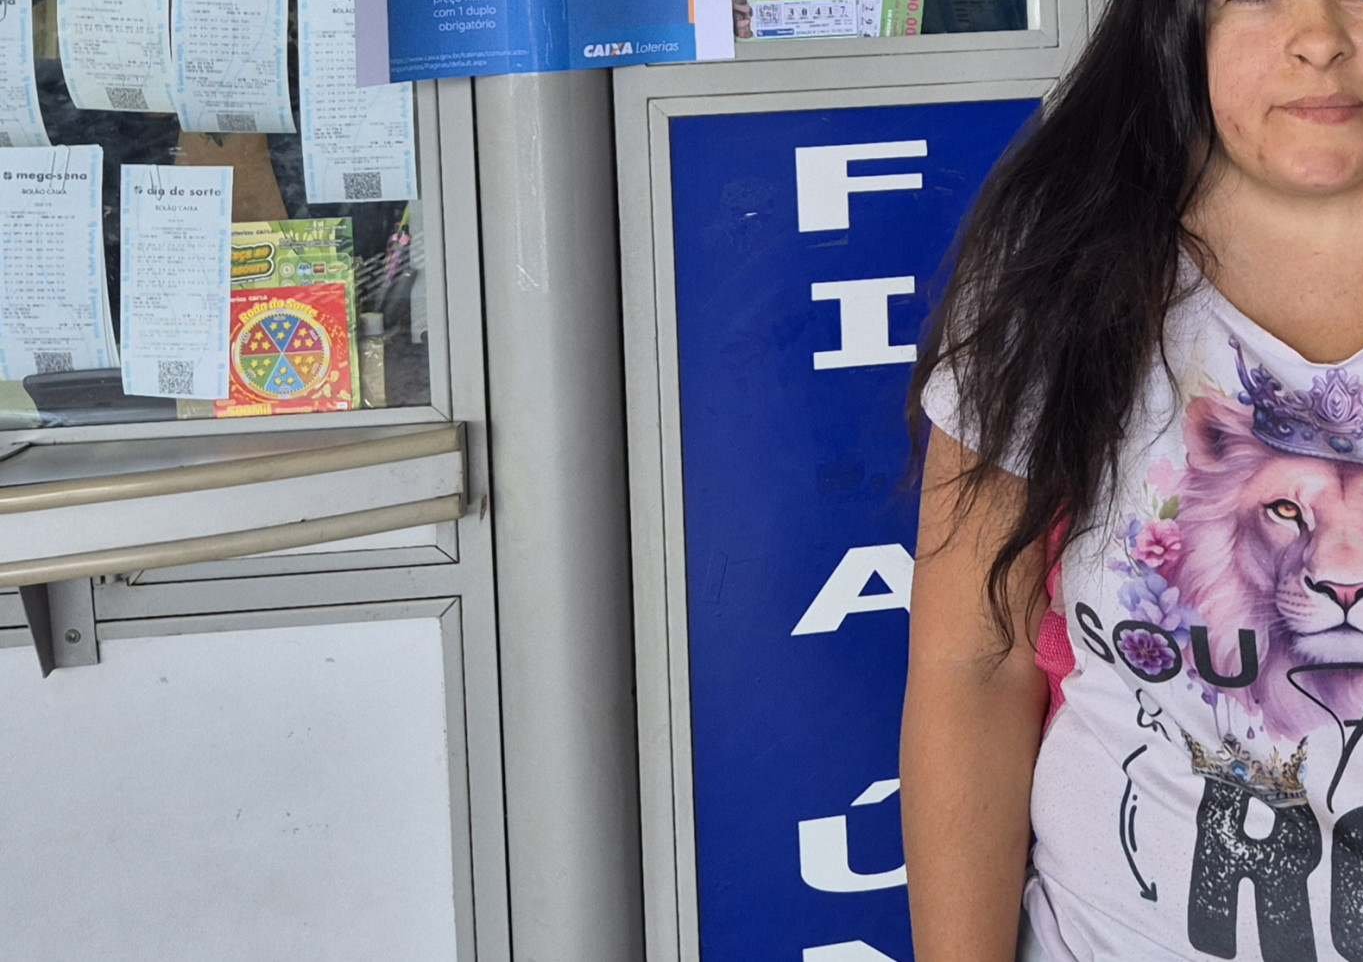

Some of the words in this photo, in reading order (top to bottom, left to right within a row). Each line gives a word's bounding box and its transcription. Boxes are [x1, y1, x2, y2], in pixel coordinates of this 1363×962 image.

[433, 8, 456, 18] com
[465, 4, 497, 18] duplo
[438, 19, 496, 33] obrigatório
[583, 41, 633, 58] CAIXA
[635, 40, 680, 55] Loterias
[16, 170, 88, 183] mega-sena
[169, 185, 185, 197] de
[1075, 601, 1259, 688] SOU
